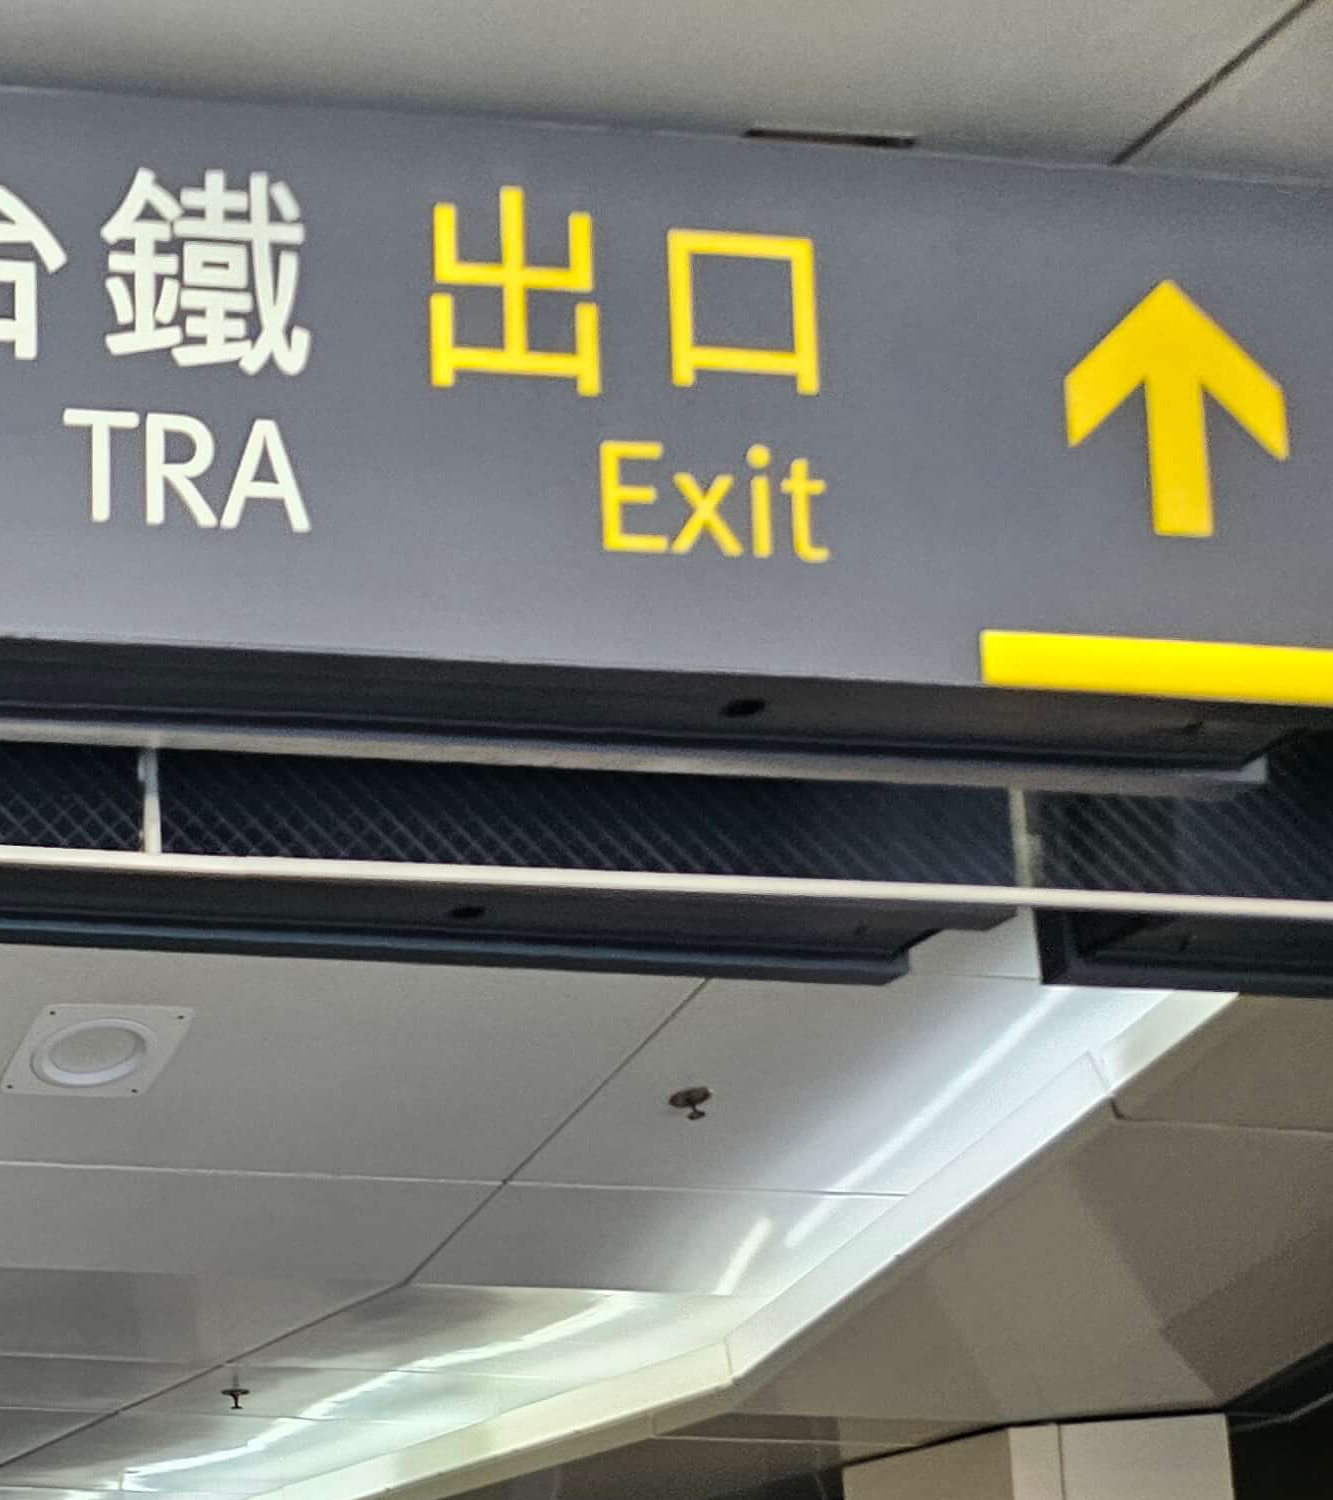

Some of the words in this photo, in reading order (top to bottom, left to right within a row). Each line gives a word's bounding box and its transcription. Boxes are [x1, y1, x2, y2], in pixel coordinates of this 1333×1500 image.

[429, 187, 819, 396] 出口
[62, 407, 312, 533] TRA
[600, 440, 831, 563] Exit
